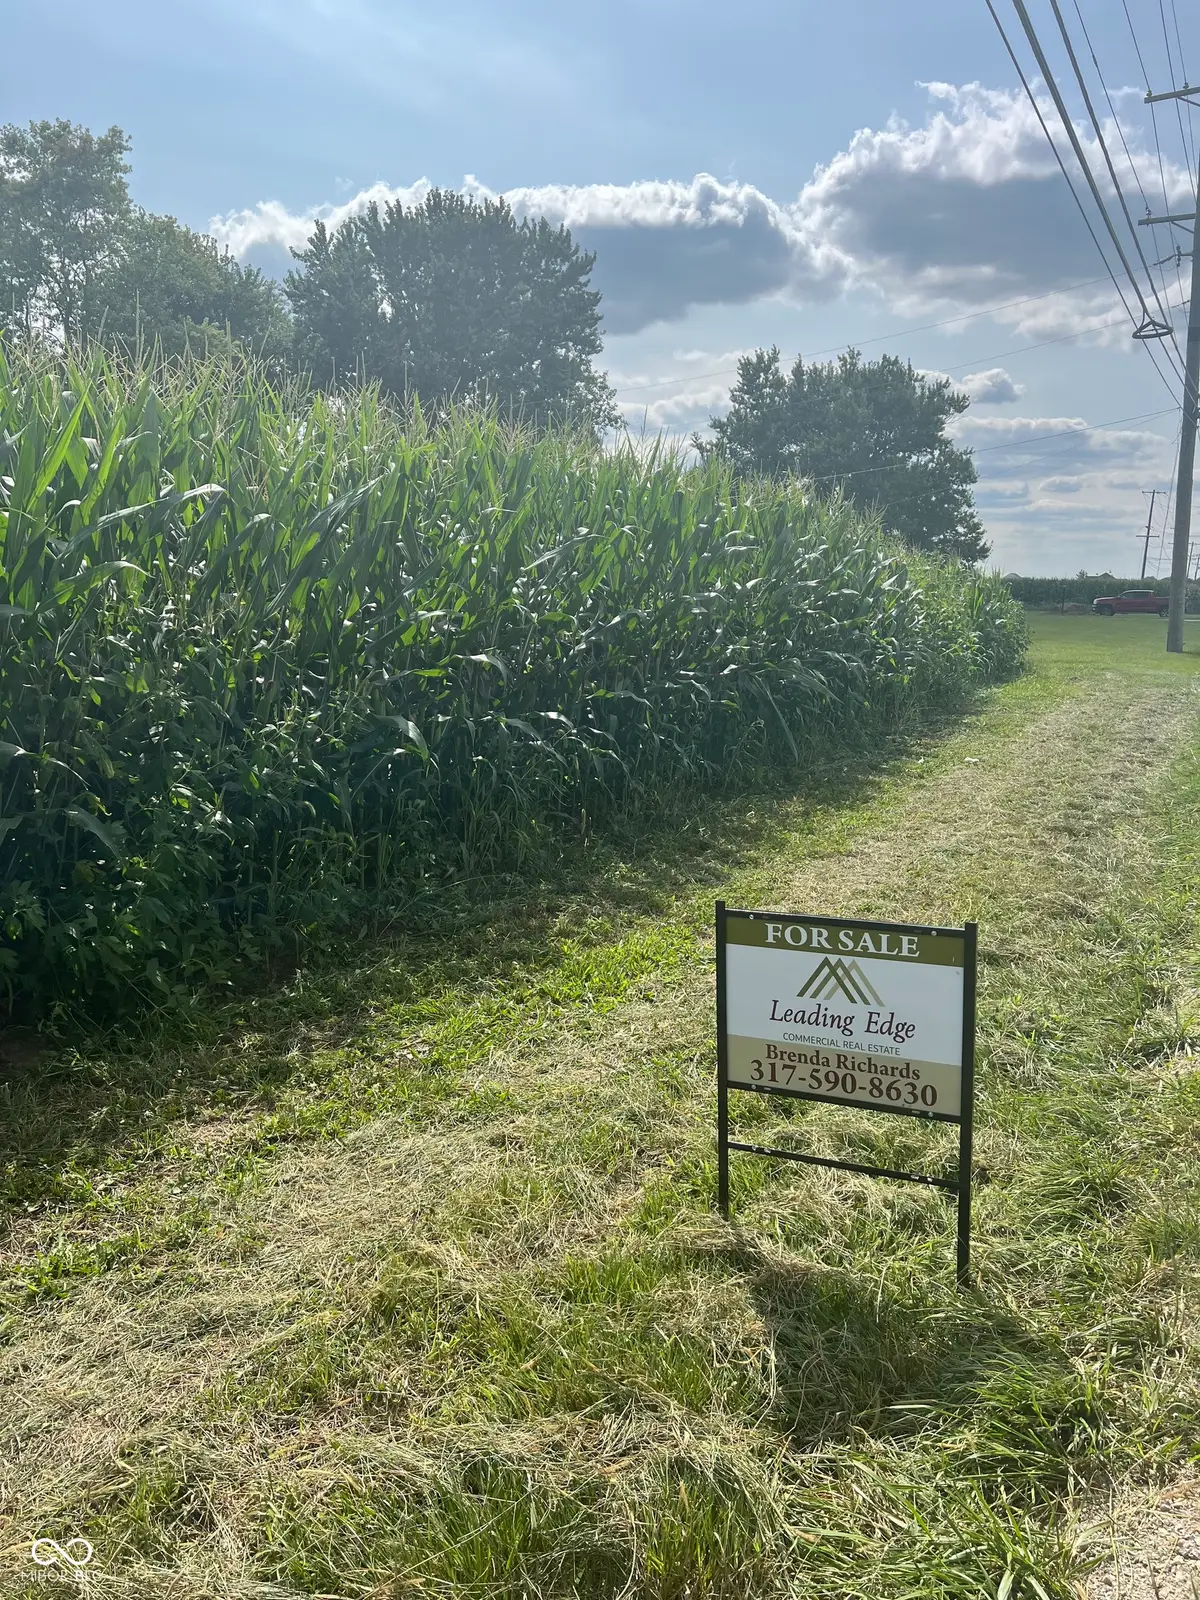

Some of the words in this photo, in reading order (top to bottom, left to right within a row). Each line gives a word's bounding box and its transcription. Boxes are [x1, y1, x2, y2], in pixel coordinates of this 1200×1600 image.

[765, 923, 832, 949] FOR
[838, 930, 919, 957] SALE
[770, 1000, 855, 1036] Leading
[865, 1012, 915, 1043] Edge
[783, 1032, 839, 1047] COMMERCIAL
[843, 1041, 865, 1051] REAL
[868, 1045, 900, 1055] ESTATE
[766, 1044, 830, 1067] Brenda
[836, 1054, 920, 1080] Richards
[751, 1060, 937, 1106] 317-590-8630
